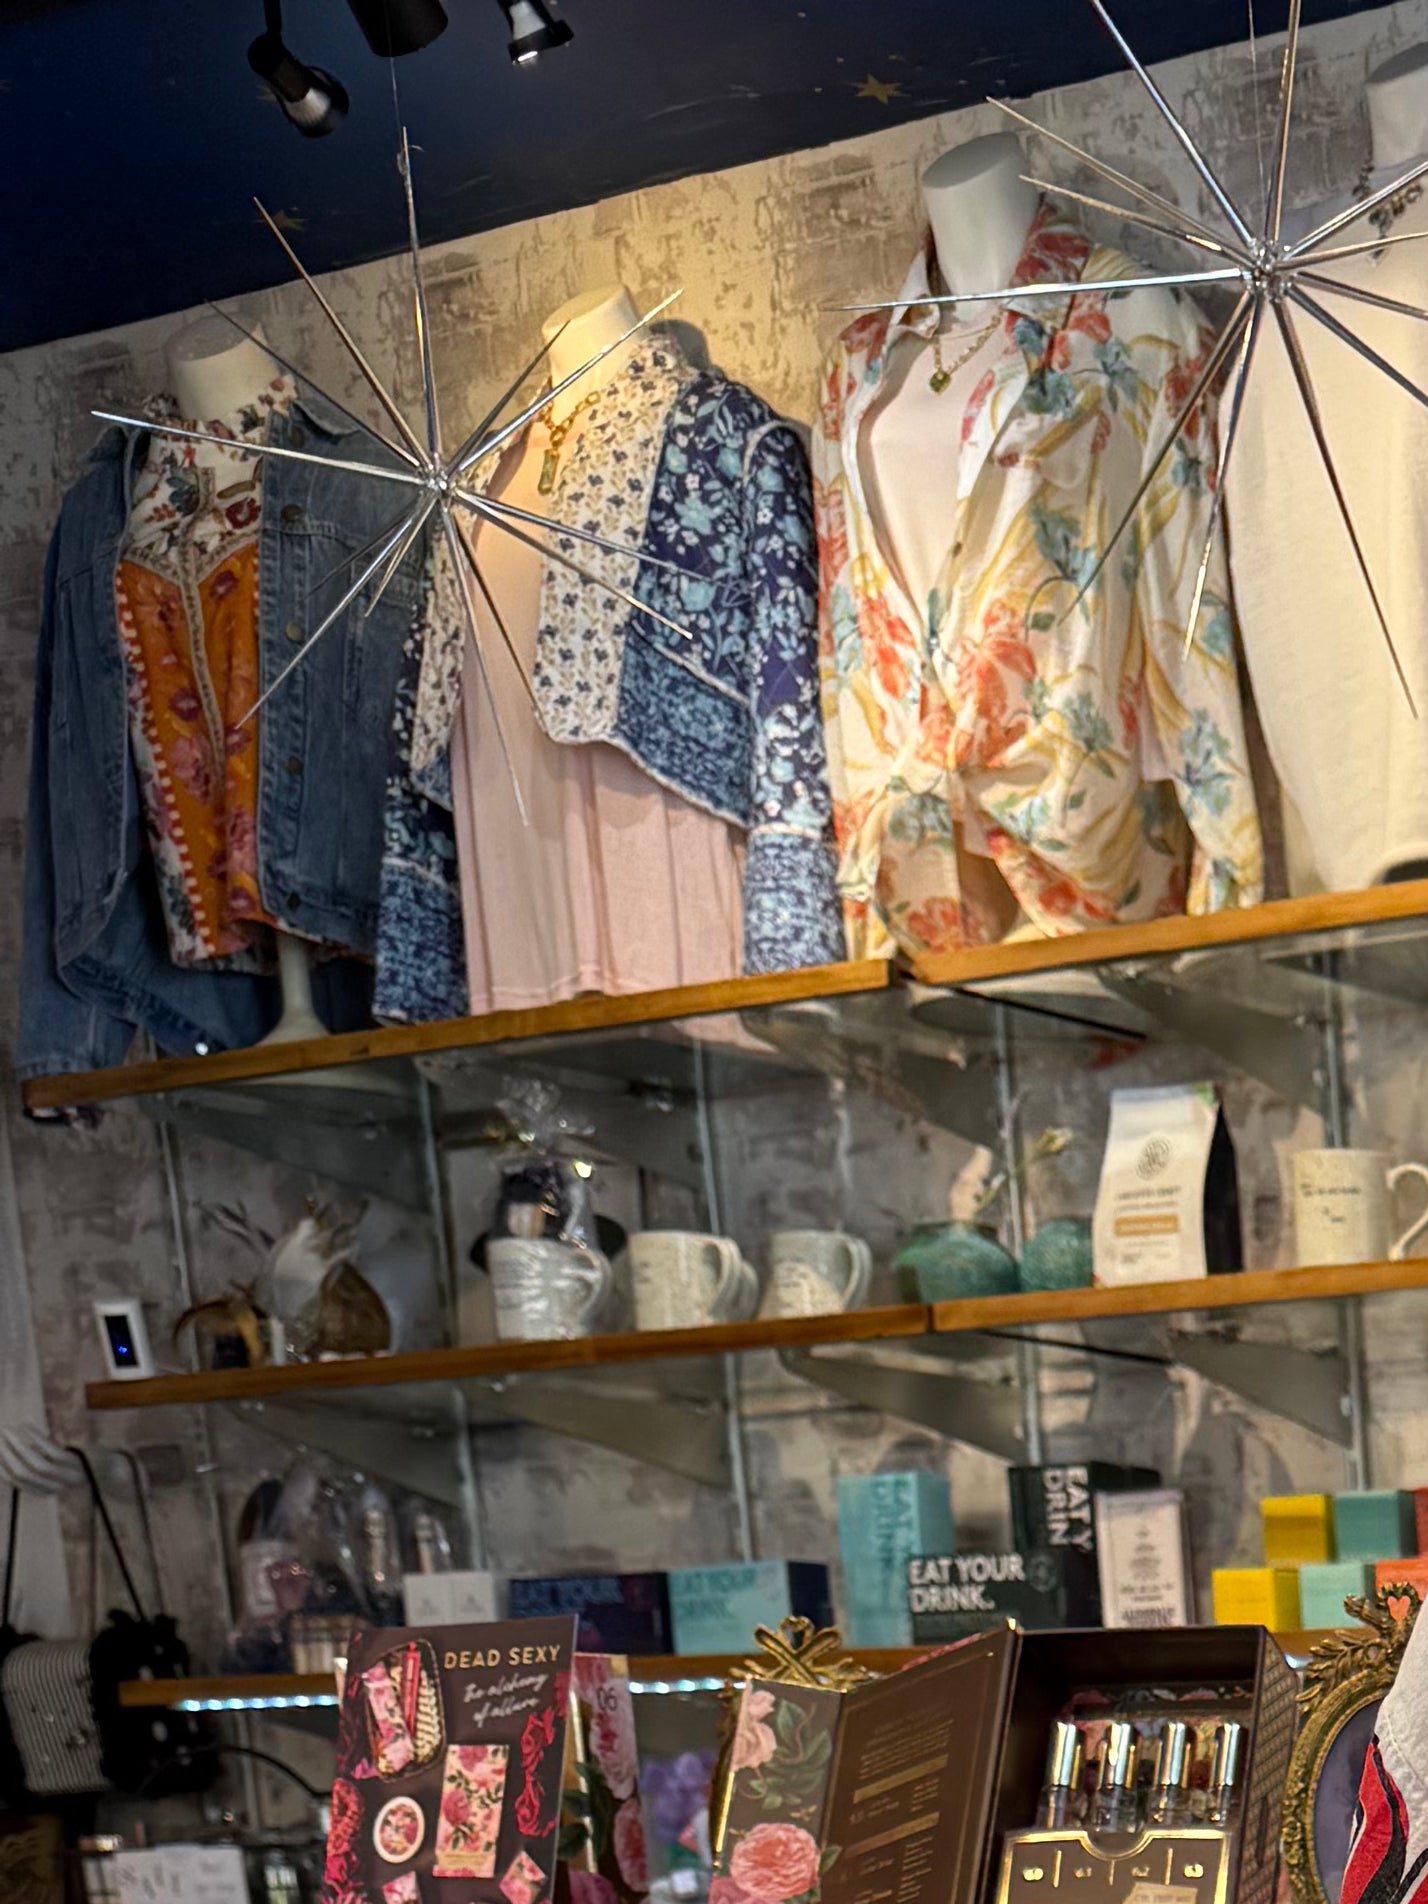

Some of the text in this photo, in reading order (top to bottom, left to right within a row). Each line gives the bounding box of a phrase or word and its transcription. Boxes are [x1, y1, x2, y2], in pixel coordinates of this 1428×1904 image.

[909, 1552, 1026, 1586] EAT YOUR
[443, 1644, 561, 1670] DEAD SEXY
